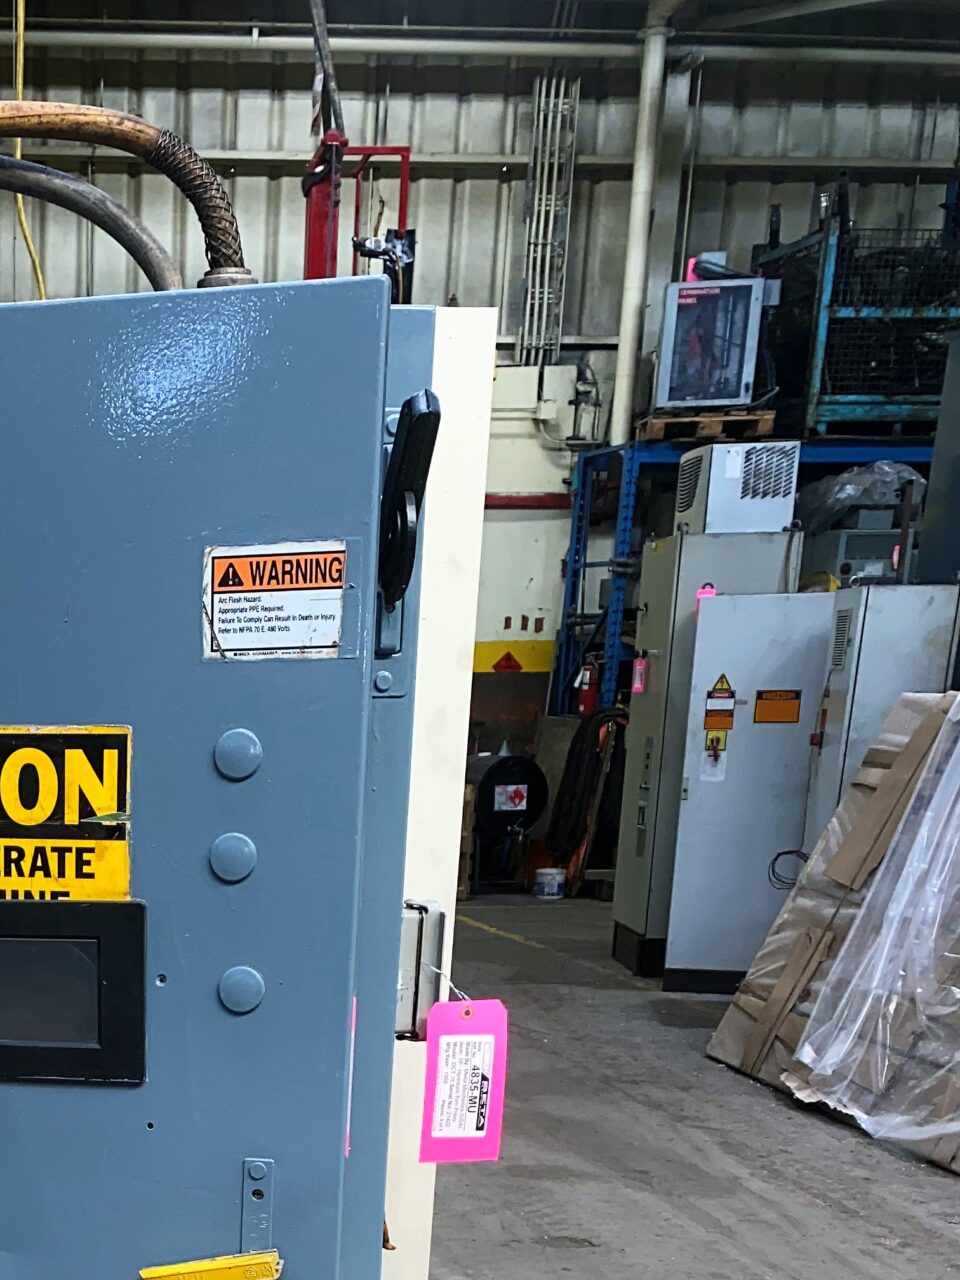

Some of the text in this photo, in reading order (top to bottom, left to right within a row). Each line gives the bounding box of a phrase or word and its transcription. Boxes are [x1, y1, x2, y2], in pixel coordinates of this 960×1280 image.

[249, 557, 342, 586] WARNING
[243, 616, 262, 624] Comply
[467, 1065, 480, 1113] 4835-MU
